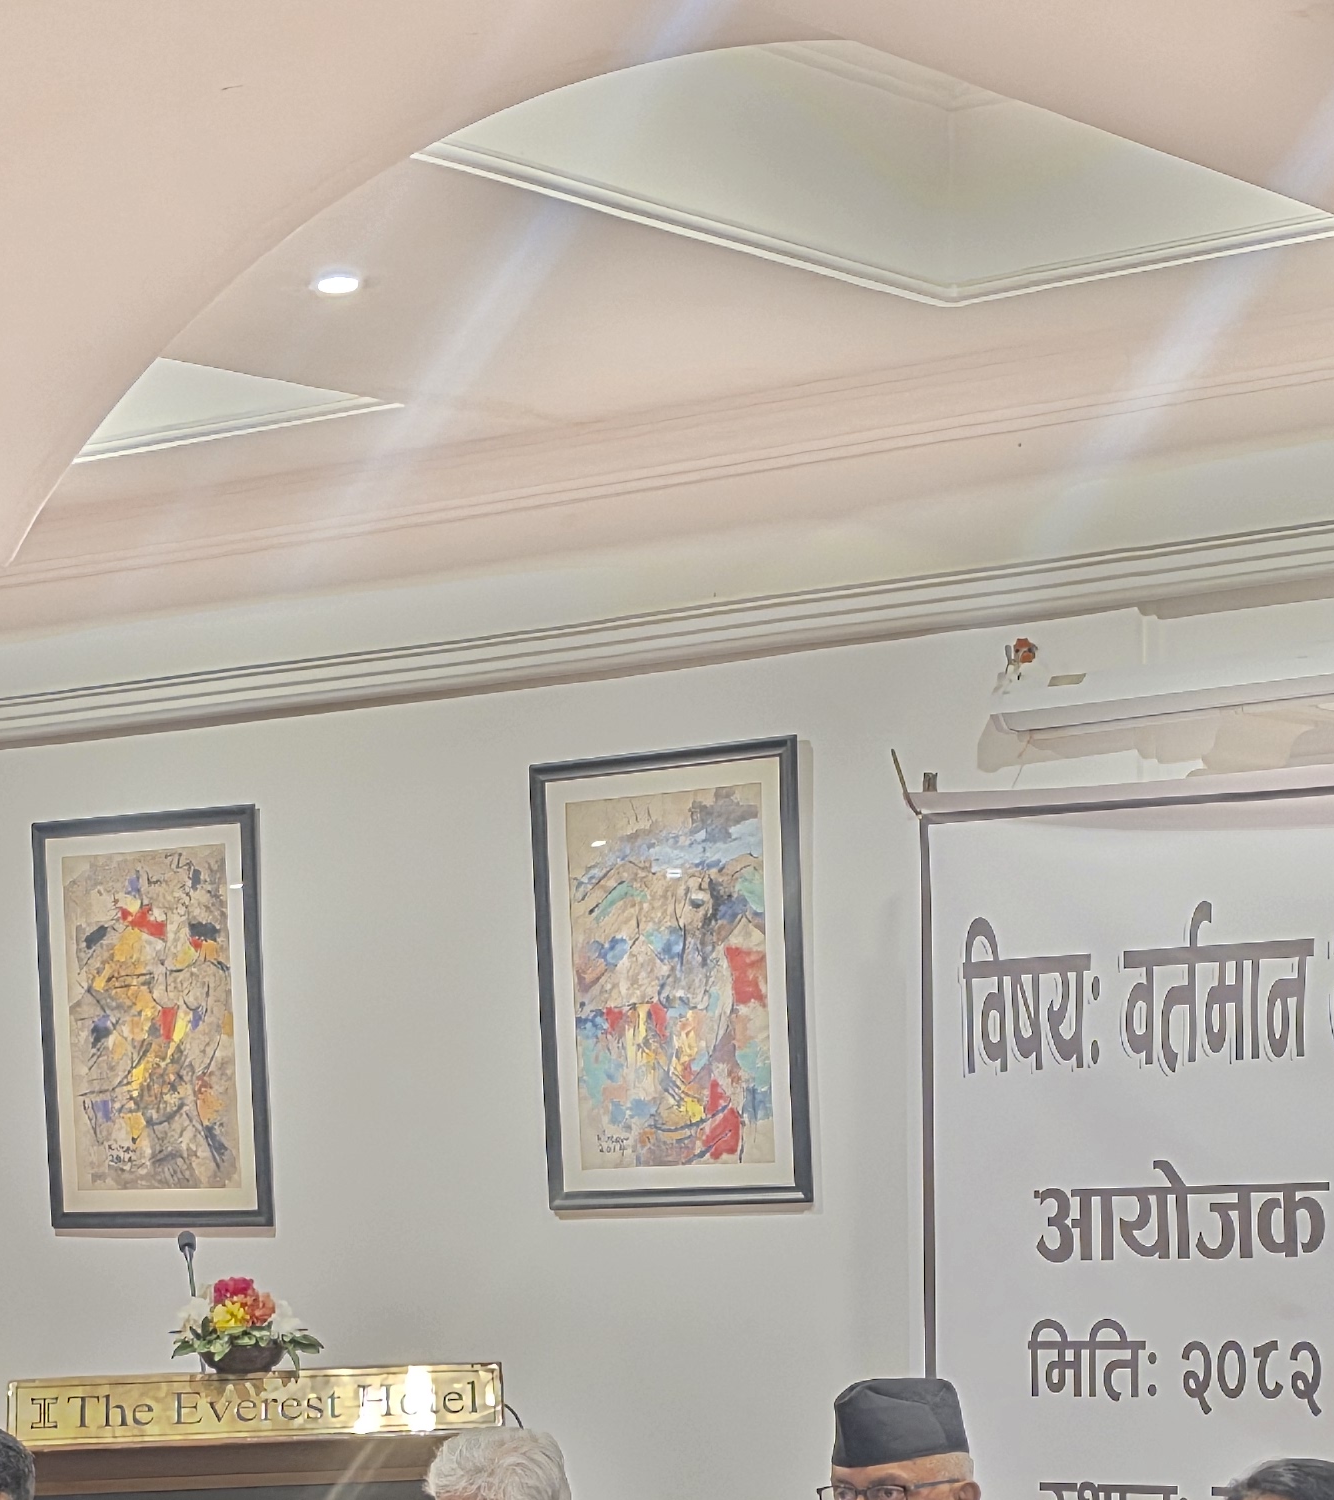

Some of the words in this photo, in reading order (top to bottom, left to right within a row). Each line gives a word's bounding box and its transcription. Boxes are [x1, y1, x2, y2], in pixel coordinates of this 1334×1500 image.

[1121, 900, 1315, 1074] वर्तमान
[67, 1394, 154, 1427] The
[172, 1390, 342, 1425] Everest
[1181, 1340, 1323, 1417] २०८२
